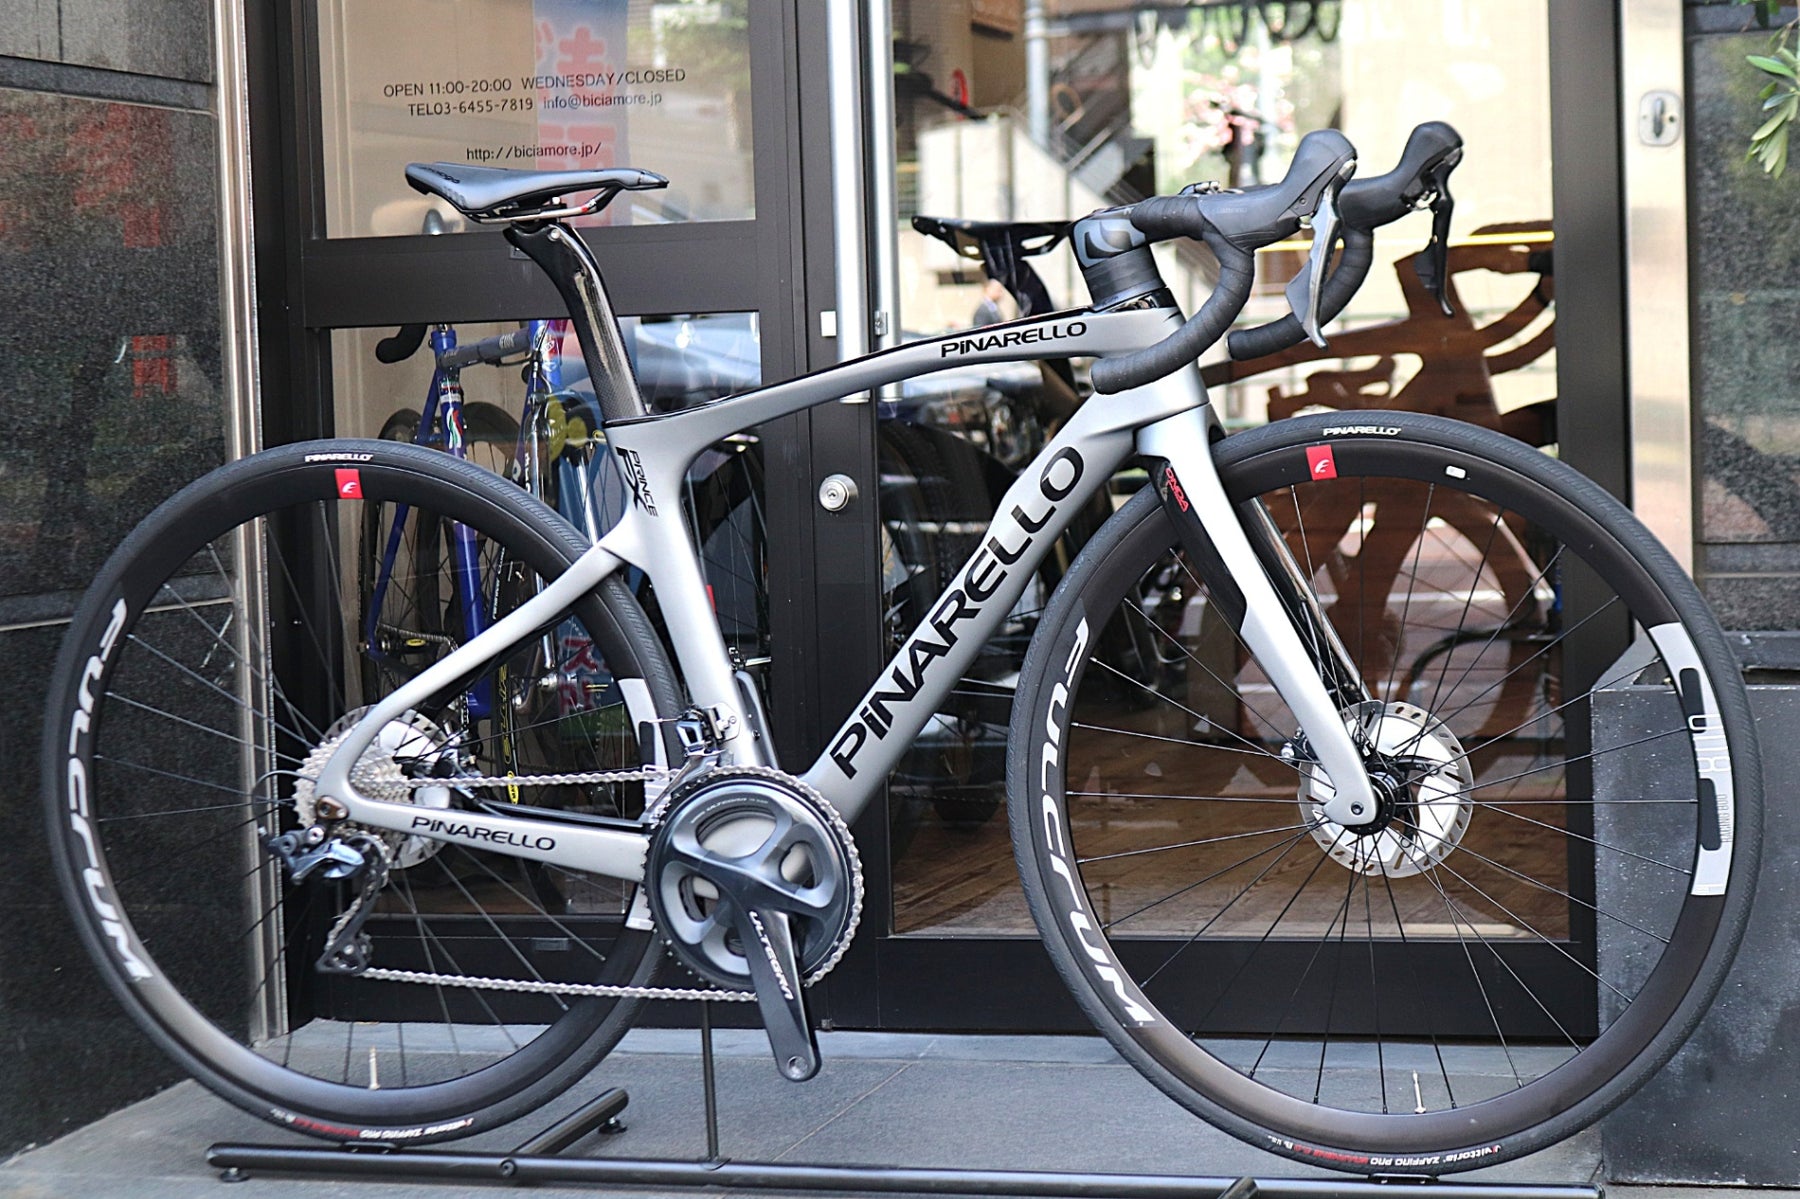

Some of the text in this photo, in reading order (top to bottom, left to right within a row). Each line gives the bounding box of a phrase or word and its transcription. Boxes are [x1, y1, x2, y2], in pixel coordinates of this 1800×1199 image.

[383, 69, 686, 98] OPEN 11:00-20:00 WEDNESDAY/CLOSED
[408, 92, 662, 117] TEL03-6455-7819 info@biciamore.jp
[466, 142, 602, 162] http://biciamore.jp/
[941, 321, 1087, 358] PINARELLO
[1323, 425, 1401, 436] PINARELLO
[304, 453, 374, 463] PINARELLO
[629, 449, 659, 517] PRINCE
[829, 446, 1085, 780] PINARELLO
[68, 598, 154, 978] FULCRUM
[411, 816, 556, 851] PINARELLO
[1041, 616, 1155, 1023] FULCRUM
[749, 911, 794, 1000] ULTEGRA
